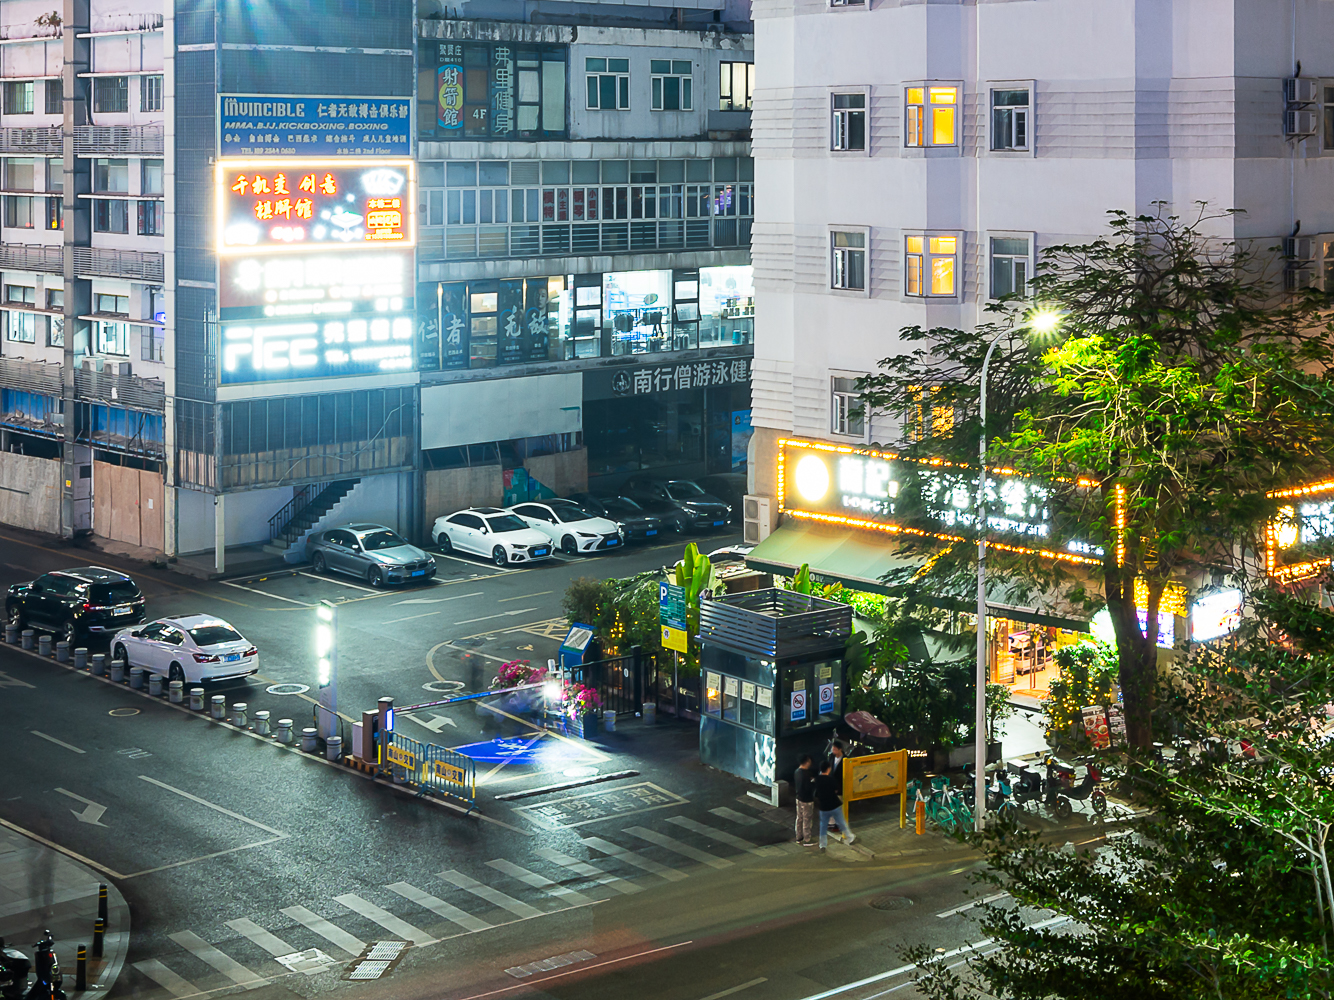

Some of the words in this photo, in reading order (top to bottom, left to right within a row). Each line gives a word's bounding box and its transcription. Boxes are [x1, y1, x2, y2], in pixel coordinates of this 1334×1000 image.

[472, 108, 487, 119] 4F
[298, 173, 337, 195] 创意
[254, 197, 313, 220] 棋牌馆
[633, 359, 752, 395] 南行僧游泳健
[661, 586, 667, 601] P
